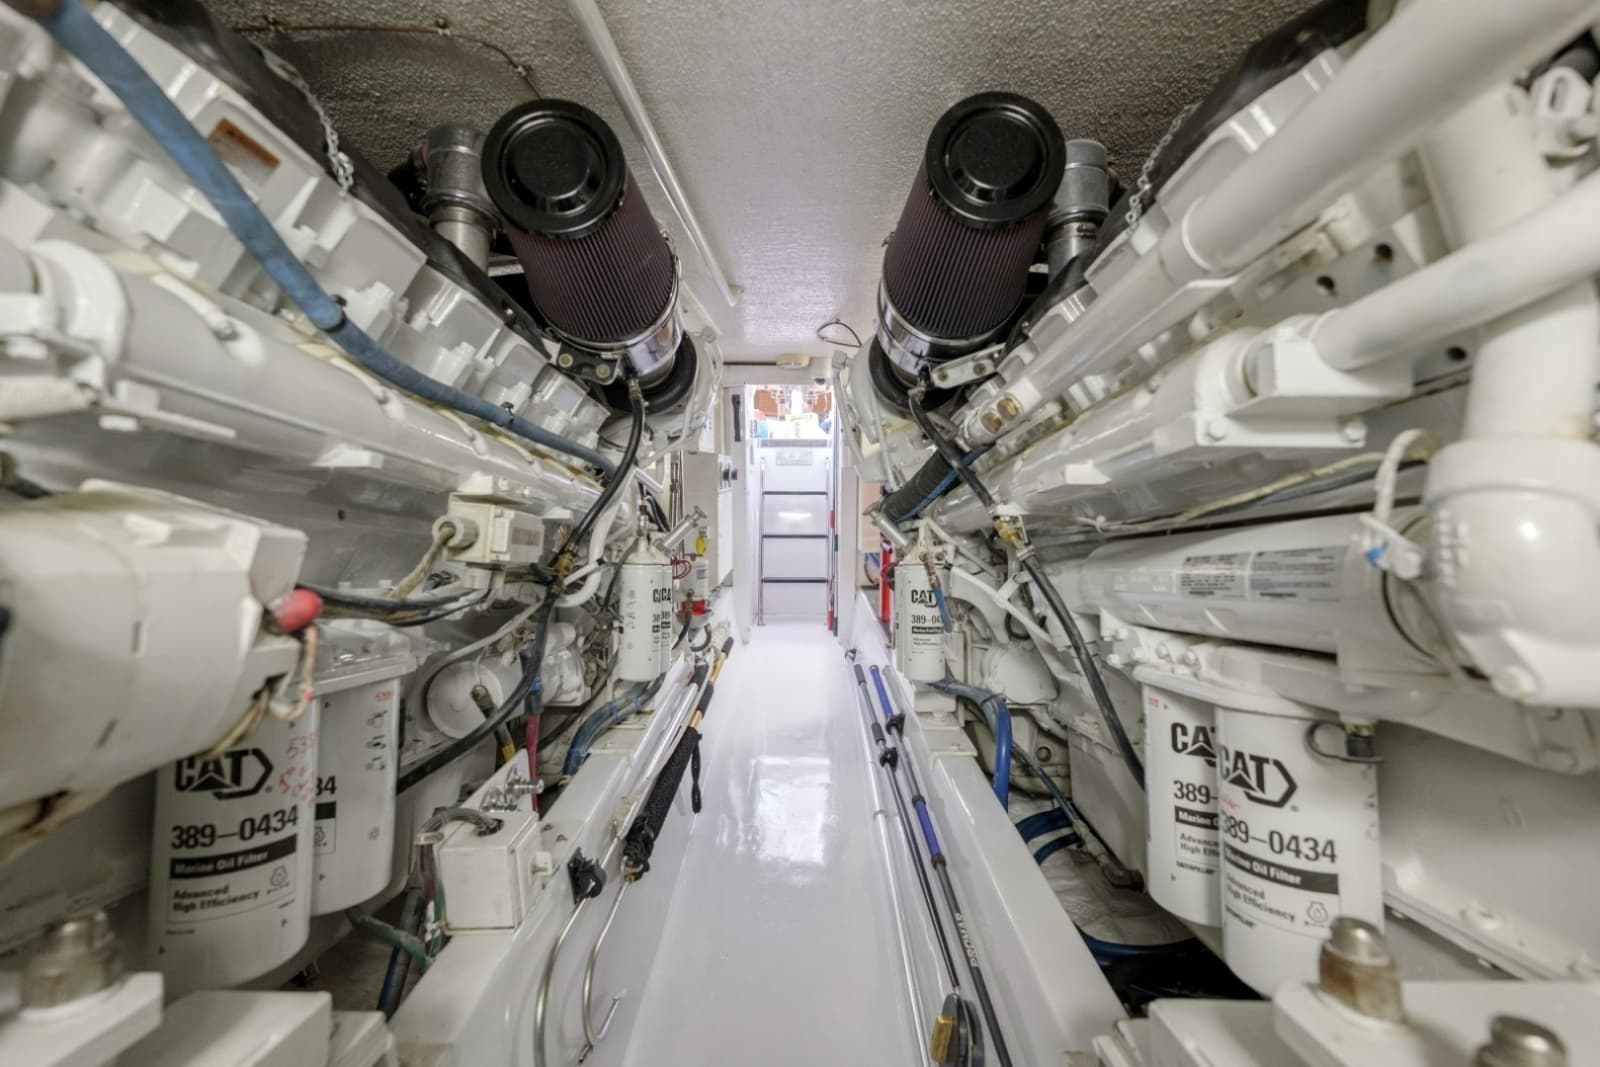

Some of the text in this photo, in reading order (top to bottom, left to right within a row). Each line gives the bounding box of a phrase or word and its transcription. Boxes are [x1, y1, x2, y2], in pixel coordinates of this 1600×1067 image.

[911, 589, 934, 604] CAT
[1171, 722, 1217, 758] CA
[175, 748, 257, 793] CAT
[1219, 744, 1275, 797] CAT
[171, 805, 299, 849] 389-0434
[1221, 811, 1337, 863] 389-0434
[215, 856, 236, 871] Oil
[237, 850, 269, 869] Filter
[1251, 860, 1268, 878] Oil
[1269, 868, 1301, 886] Filter
[173, 901, 197, 913] High
[200, 890, 260, 910] Efficiency
[174, 884, 230, 900] Advanced
[1243, 893, 1295, 923] Efficiency
